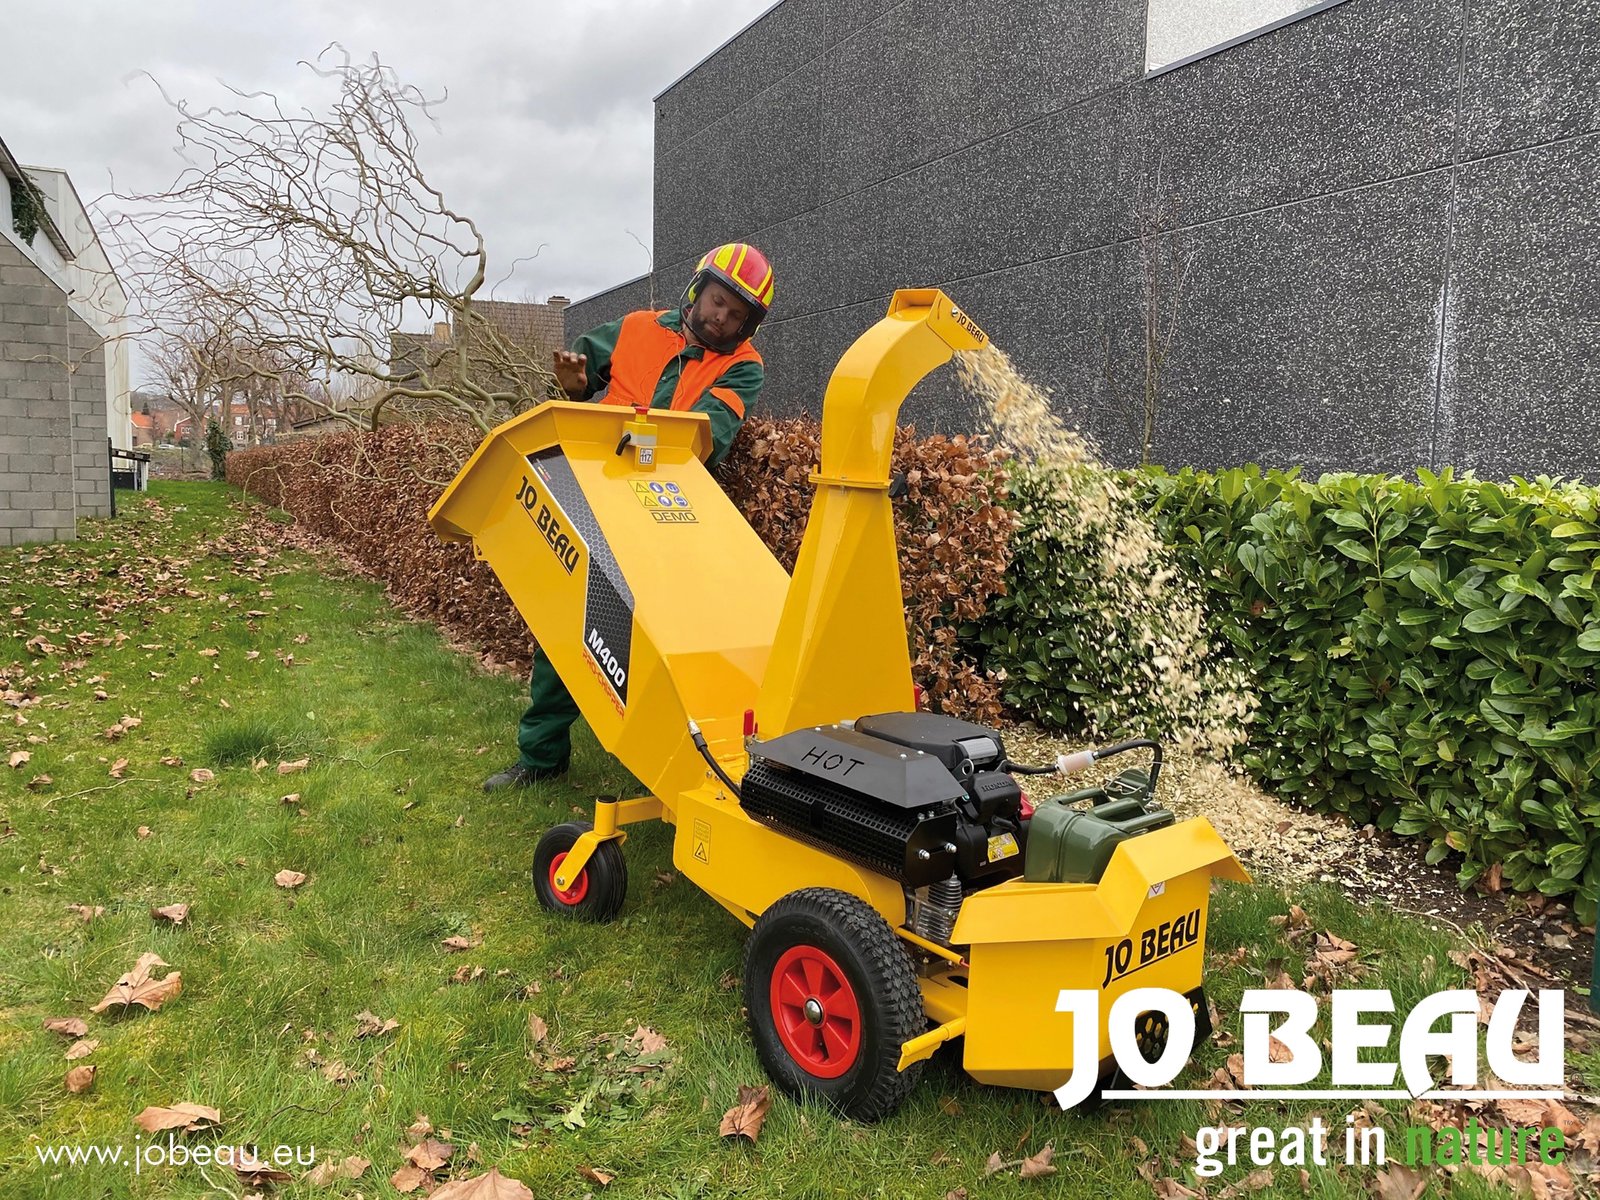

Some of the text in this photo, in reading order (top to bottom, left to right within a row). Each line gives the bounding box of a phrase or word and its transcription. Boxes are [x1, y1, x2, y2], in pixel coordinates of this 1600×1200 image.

[957, 313, 984, 342] JO BEAU
[516, 475, 537, 510] JO
[537, 504, 580, 573] BEAU
[651, 512, 697, 522] DEMO
[588, 627, 626, 688] M400
[800, 746, 865, 776] HOT
[1102, 908, 1201, 990] JO BEAU
